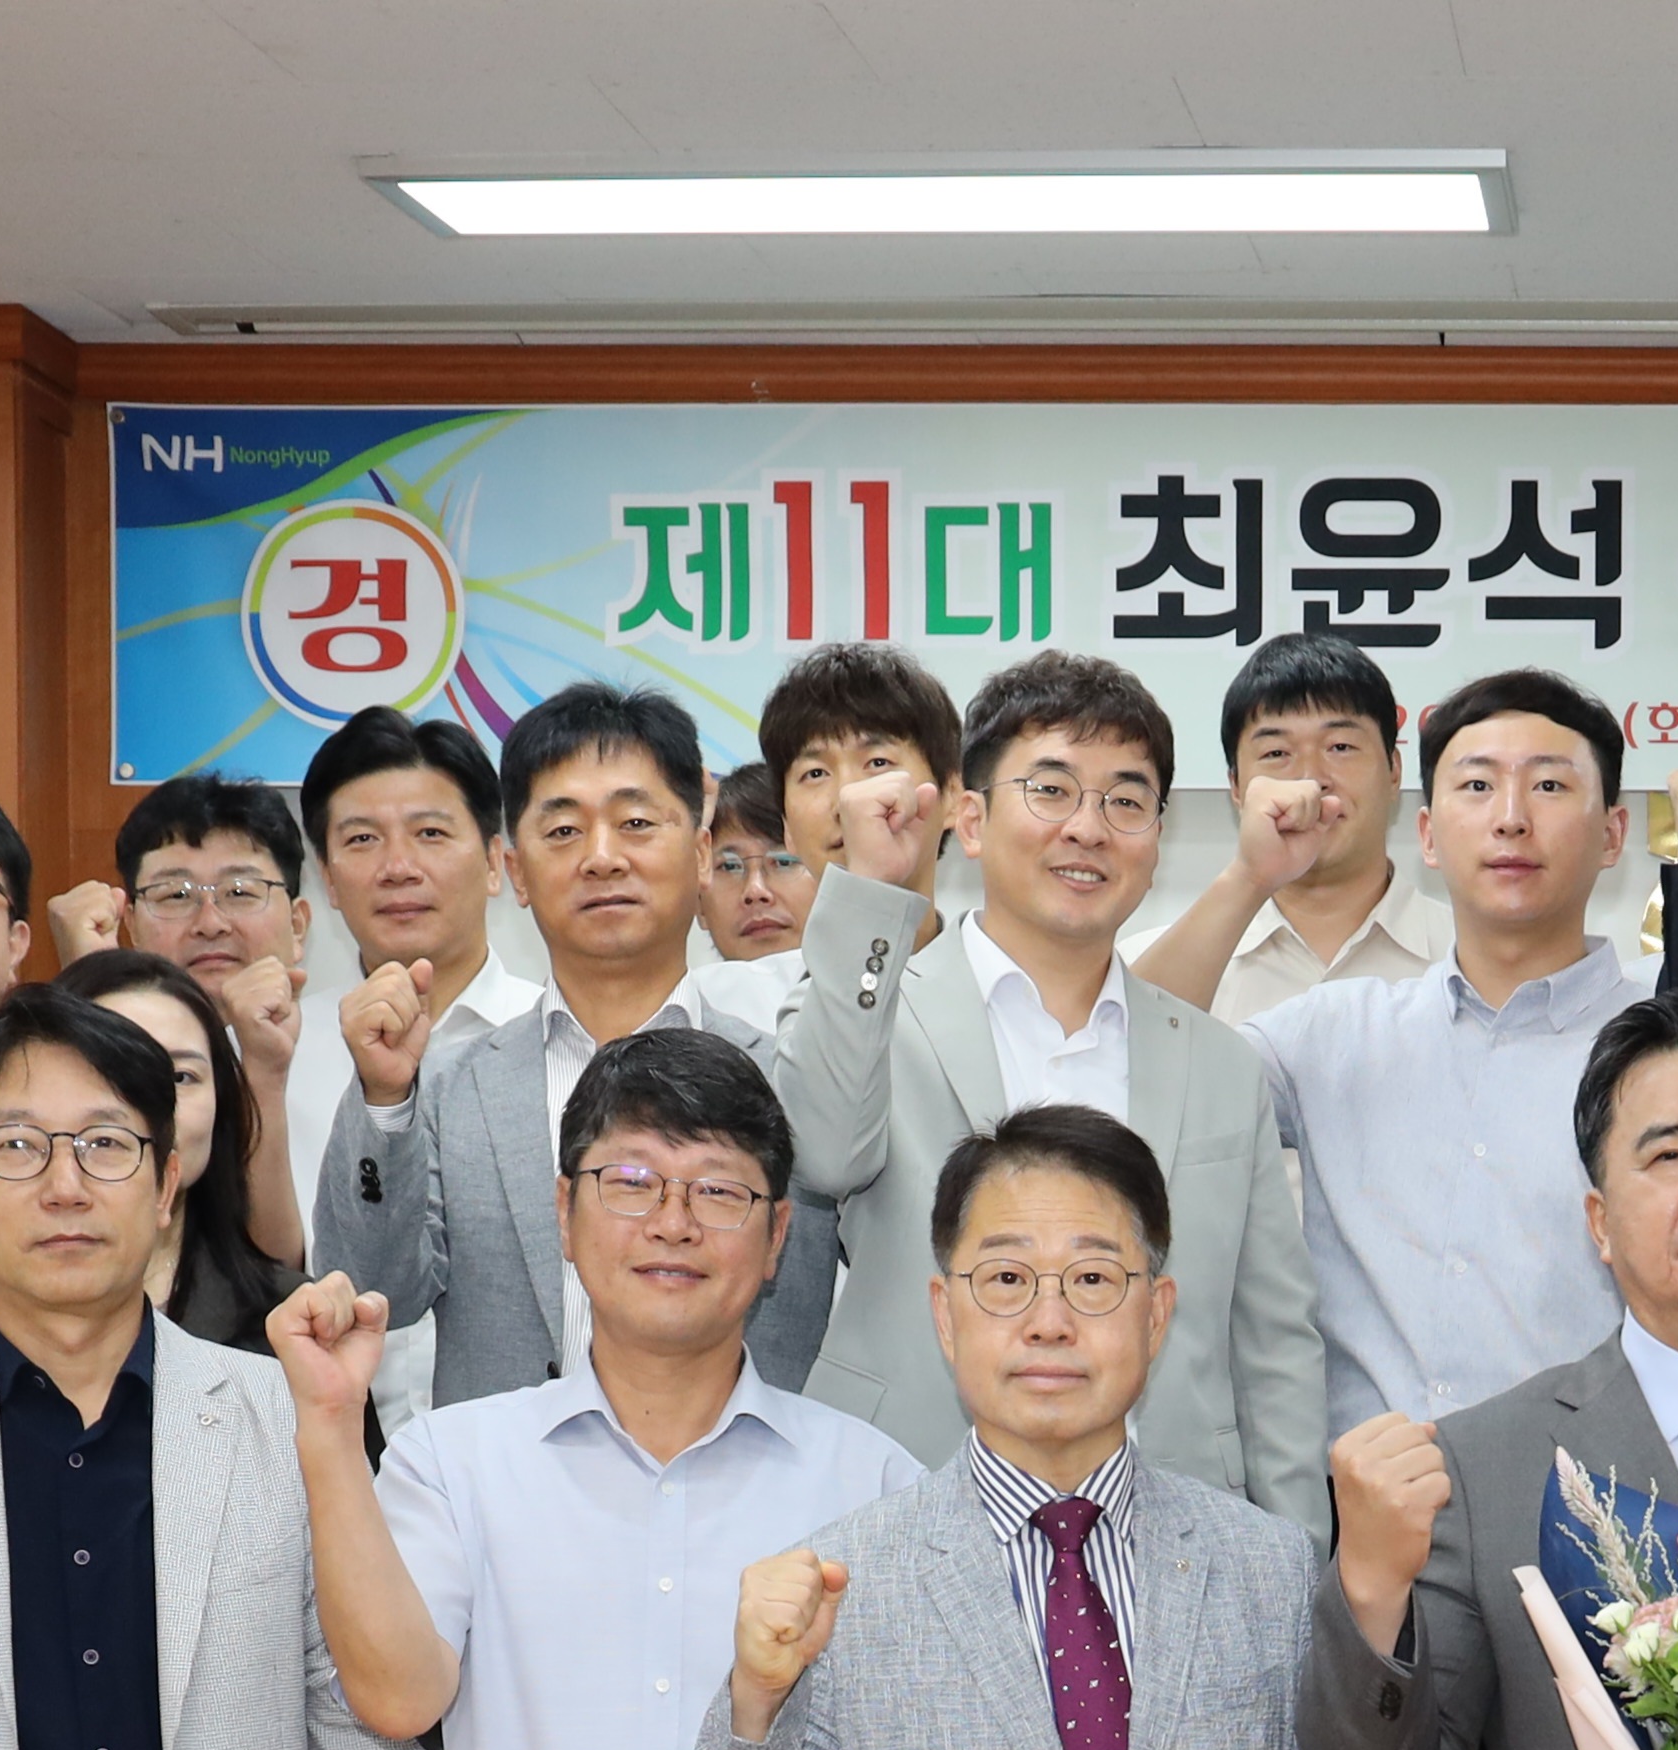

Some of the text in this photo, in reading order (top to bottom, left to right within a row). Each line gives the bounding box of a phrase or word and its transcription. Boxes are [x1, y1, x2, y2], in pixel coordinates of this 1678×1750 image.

[141, 433, 331, 473] NH NongHyup
[288, 557, 408, 673] 경
[618, 480, 1052, 642] 제11대
[1112, 474, 1623, 650] 최윤석
